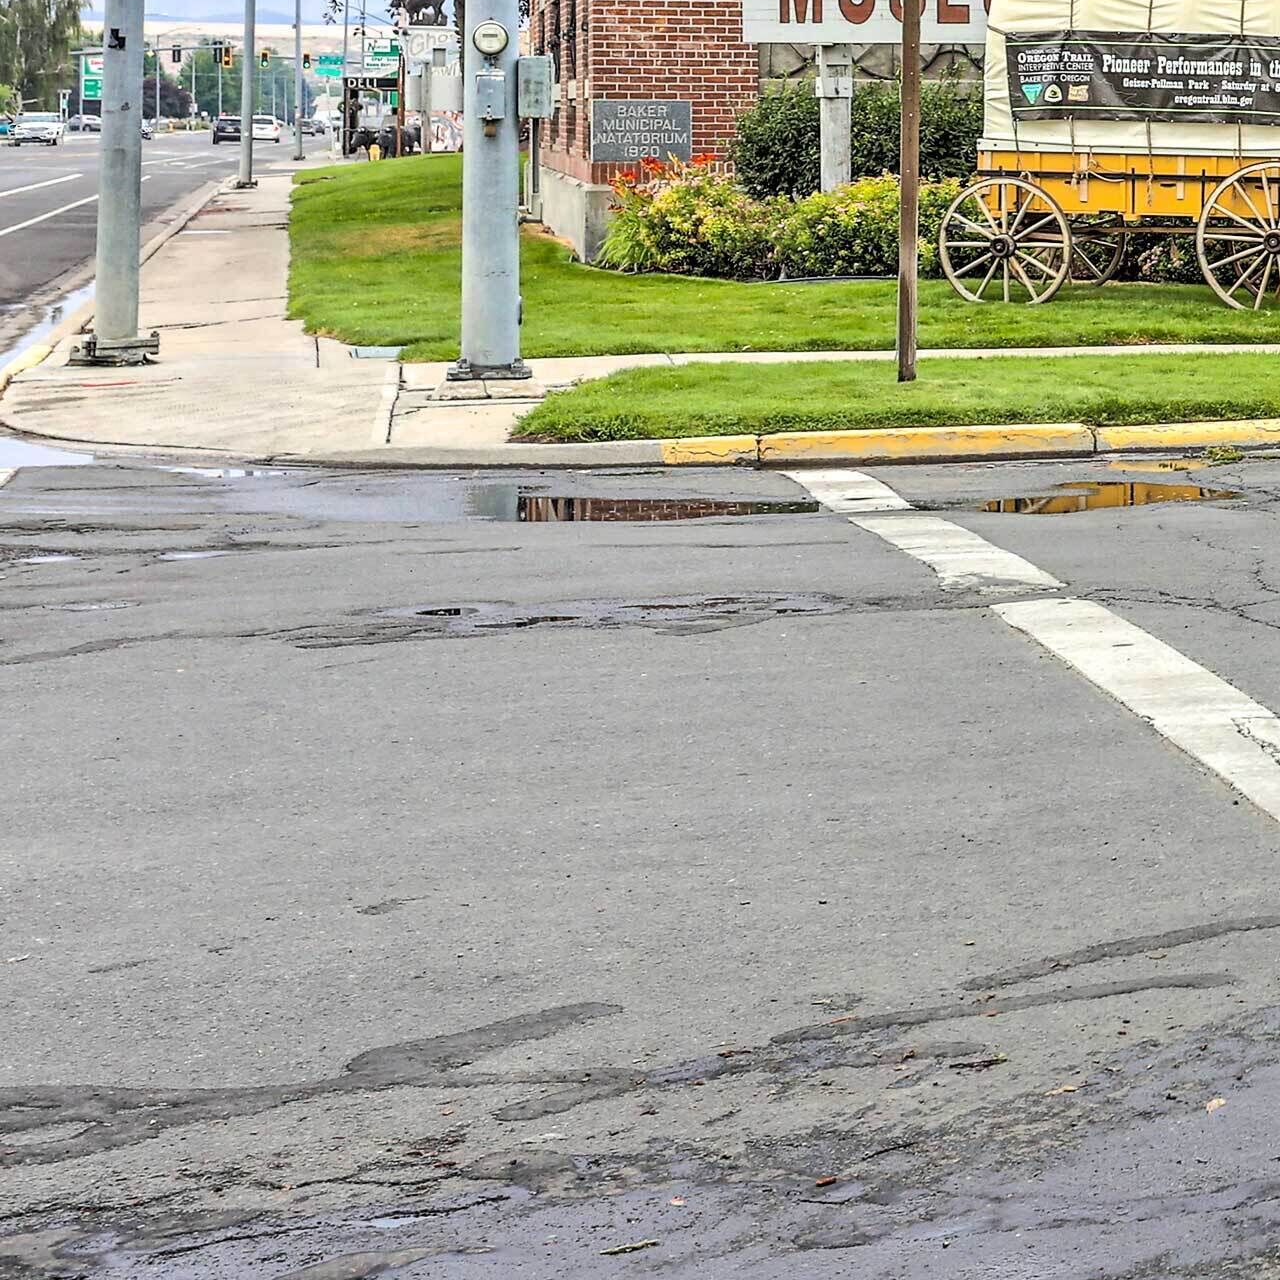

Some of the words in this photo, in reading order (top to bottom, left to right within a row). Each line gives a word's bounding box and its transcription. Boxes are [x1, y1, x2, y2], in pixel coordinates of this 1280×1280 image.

[1017, 52, 1059, 63] OREGON
[1061, 51, 1094, 62] TRAIL
[1018, 62, 1064, 71] INTERPRETIVE
[1066, 62, 1093, 70] CENTER
[1102, 54, 1150, 73] Pioneer
[1157, 56, 1243, 76] Performances
[1250, 58, 1262, 76] in
[347, 78, 377, 88] DELI
[1020, 75, 1041, 83] BAKER
[1060, 73, 1090, 82] OREGON
[1189, 79, 1209, 90] Park
[1261, 82, 1270, 91] at
[617, 105, 667, 117] BAKER
[602, 119, 681, 130] MUNICIPAL
[596, 132, 687, 144] NATATORIUM
[624, 146, 659, 157] 1920
